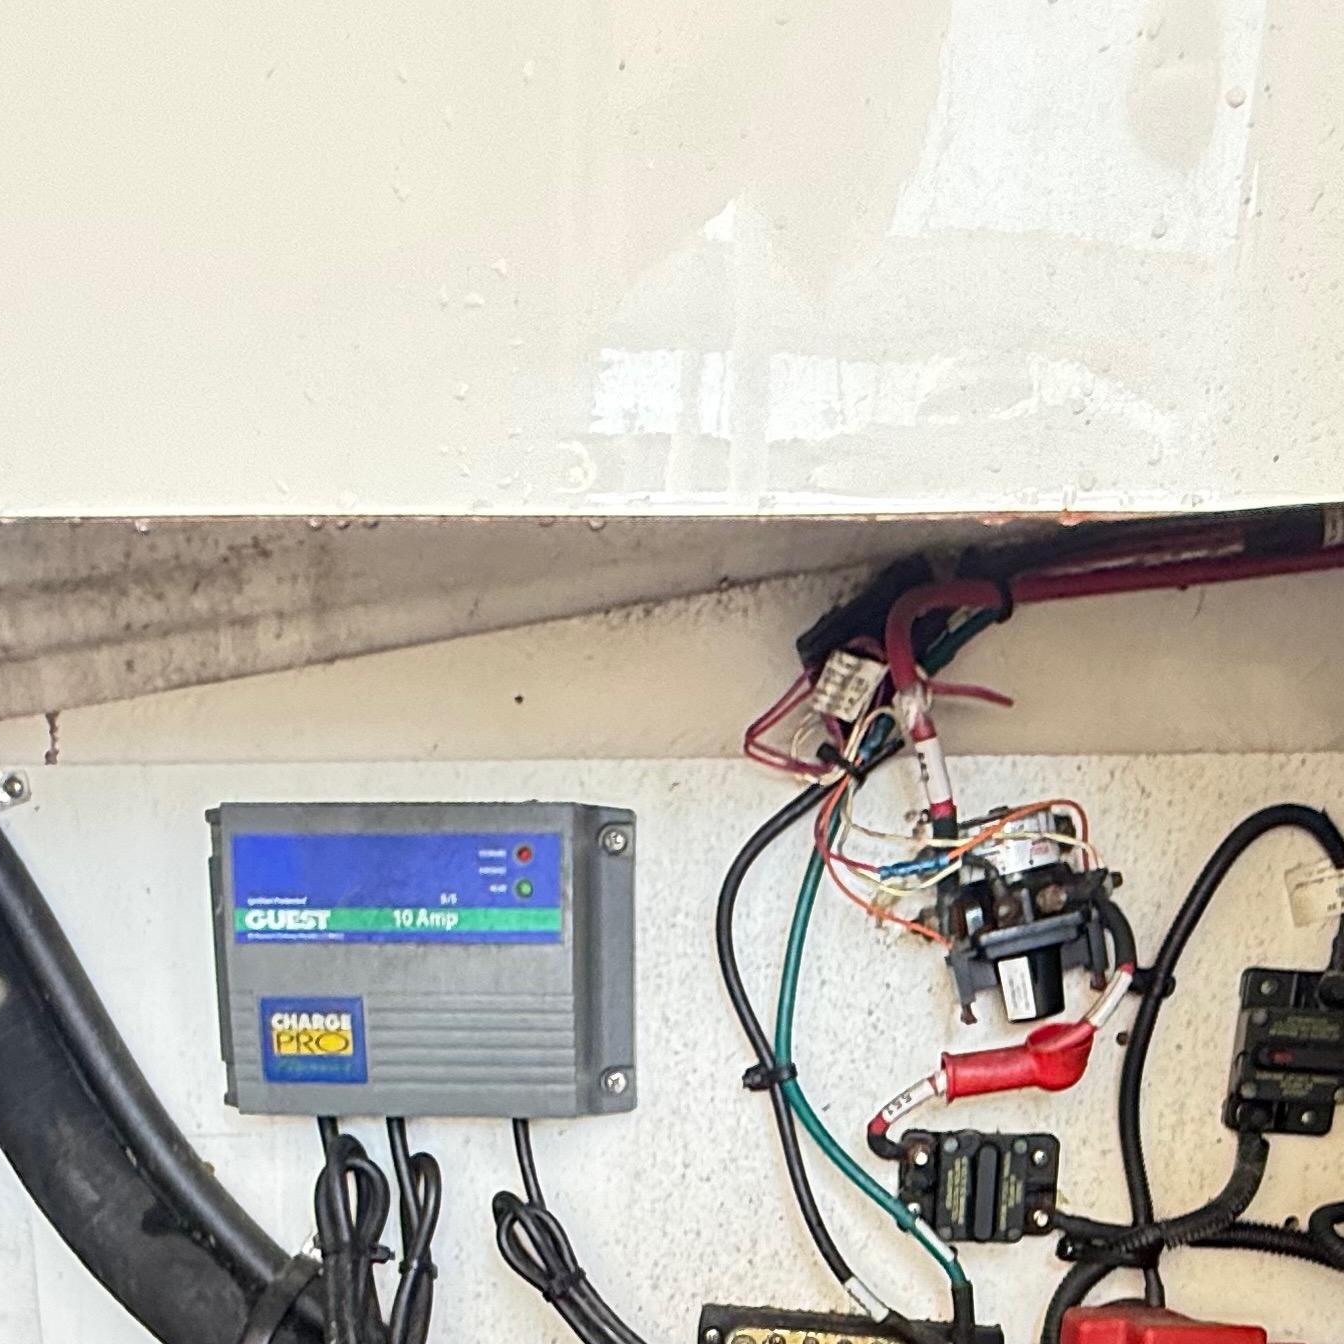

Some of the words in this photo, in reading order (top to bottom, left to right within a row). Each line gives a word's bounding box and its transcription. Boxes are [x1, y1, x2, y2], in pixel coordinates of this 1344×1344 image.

[244, 908, 331, 930] GUEST
[392, 908, 414, 928] 10
[416, 908, 459, 930] Amp
[271, 1013, 351, 1031] CHARGE
[276, 1032, 350, 1053] PRO
